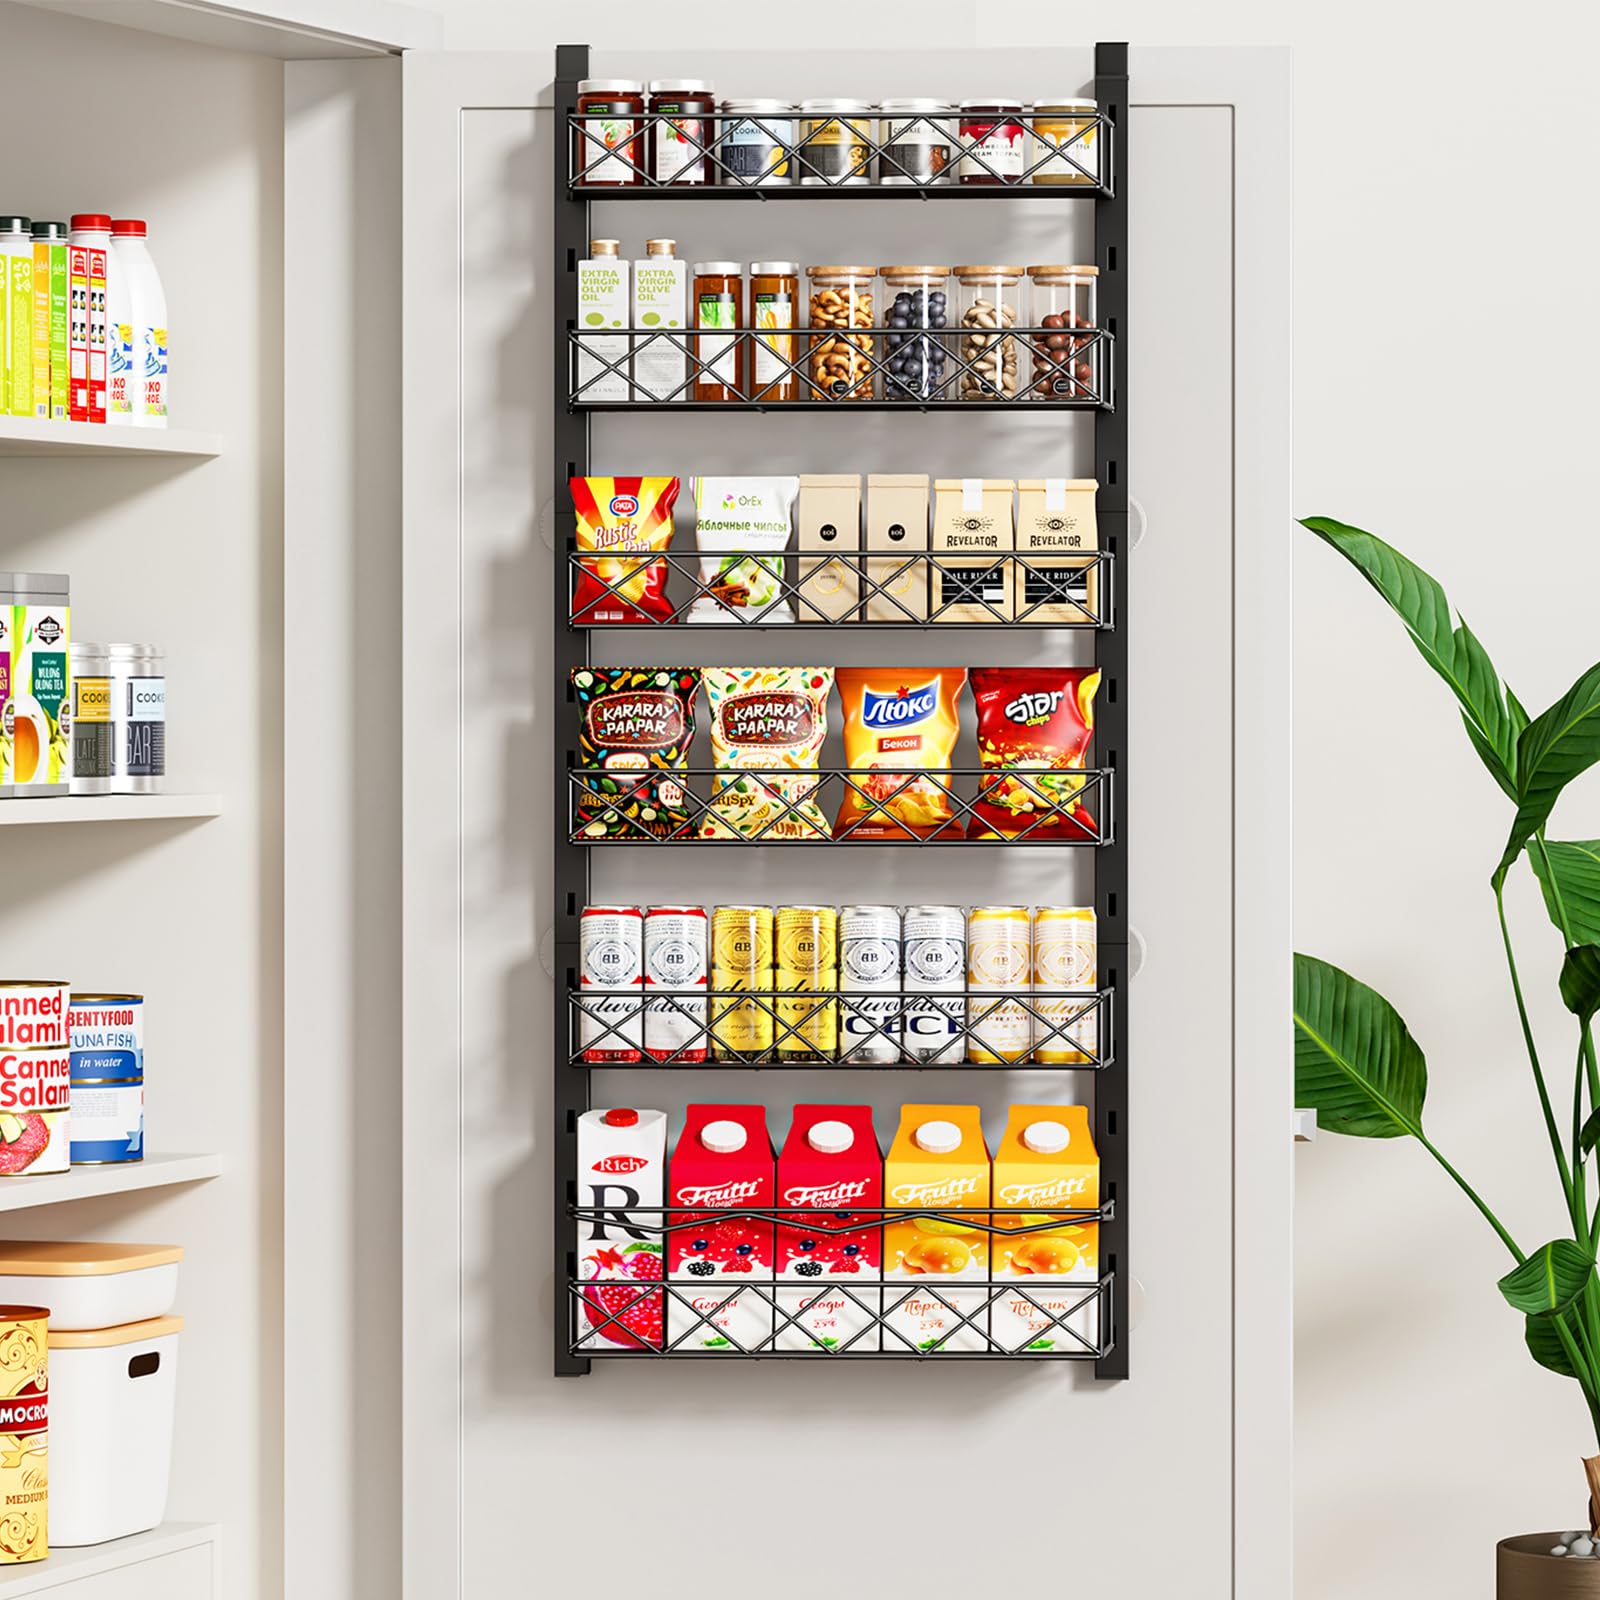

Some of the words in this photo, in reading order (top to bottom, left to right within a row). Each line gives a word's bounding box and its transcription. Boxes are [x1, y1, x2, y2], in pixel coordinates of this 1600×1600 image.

[581, 270, 618, 278] EXTRA
[638, 270, 674, 278] EXTRA
[581, 293, 600, 301] OIL
[638, 293, 656, 301] OIL
[738, 495, 762, 506] OrEx
[697, 520, 751, 531] Яблочные
[753, 522, 787, 532] чипсы
[594, 521, 638, 549] Rustic
[946, 535, 998, 547] REVELATOR
[1030, 535, 1081, 547] REVELATOR
[603, 703, 674, 721] KARARAY
[734, 703, 806, 721] KARARAY
[864, 694, 934, 722] Люкс
[1026, 715, 1050, 727] chips
[606, 719, 666, 736] PAAPAR
[737, 719, 798, 736] PAAPAR
[882, 738, 917, 750] Бекон
[734, 942, 752, 952] AB
[798, 942, 815, 952] AB
[602, 954, 620, 964] AB
[666, 954, 684, 964] AB
[861, 953, 878, 962] AB
[925, 953, 943, 962] AB
[0, 990, 62, 1016] nned
[106, 1033, 132, 1048] FISH
[80, 1057, 91, 1067] in
[94, 1057, 122, 1067] water
[600, 1158, 640, 1172] Rich
[676, 1178, 763, 1206] Frutti
[784, 1178, 871, 1206] Frutti
[891, 1174, 983, 1204] Frutti
[1000, 1174, 1092, 1204] Frutti
[587, 1184, 650, 1240] R
